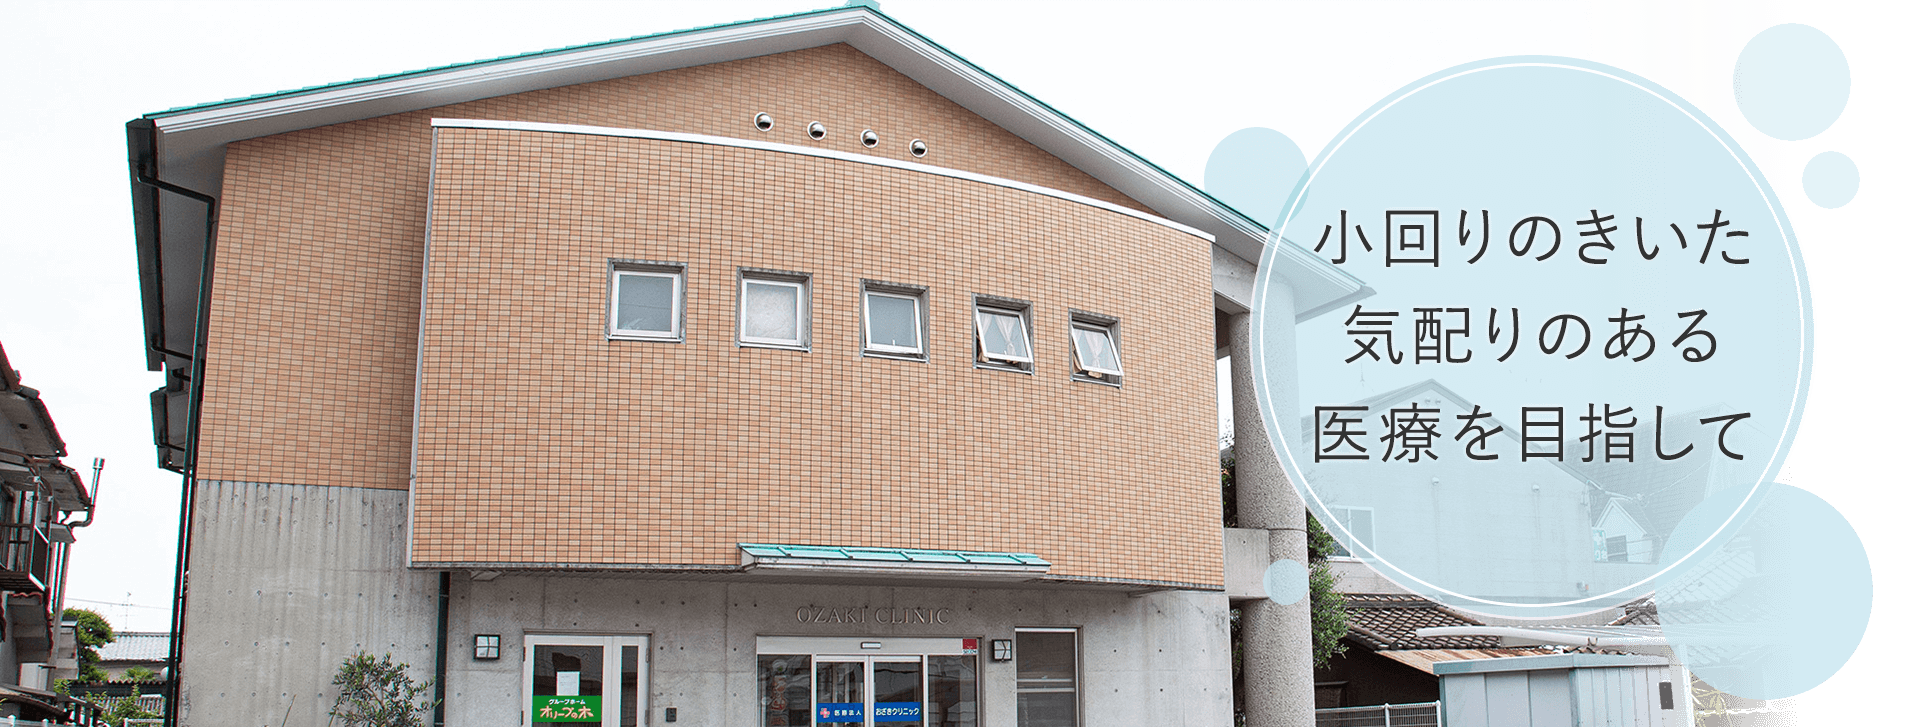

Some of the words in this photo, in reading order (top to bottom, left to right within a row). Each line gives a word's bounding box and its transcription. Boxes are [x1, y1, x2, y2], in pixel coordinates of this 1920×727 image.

[796, 605, 866, 624] OZAKI
[875, 606, 950, 625] CLINIC
[875, 707, 920, 716] おざきクリニック
